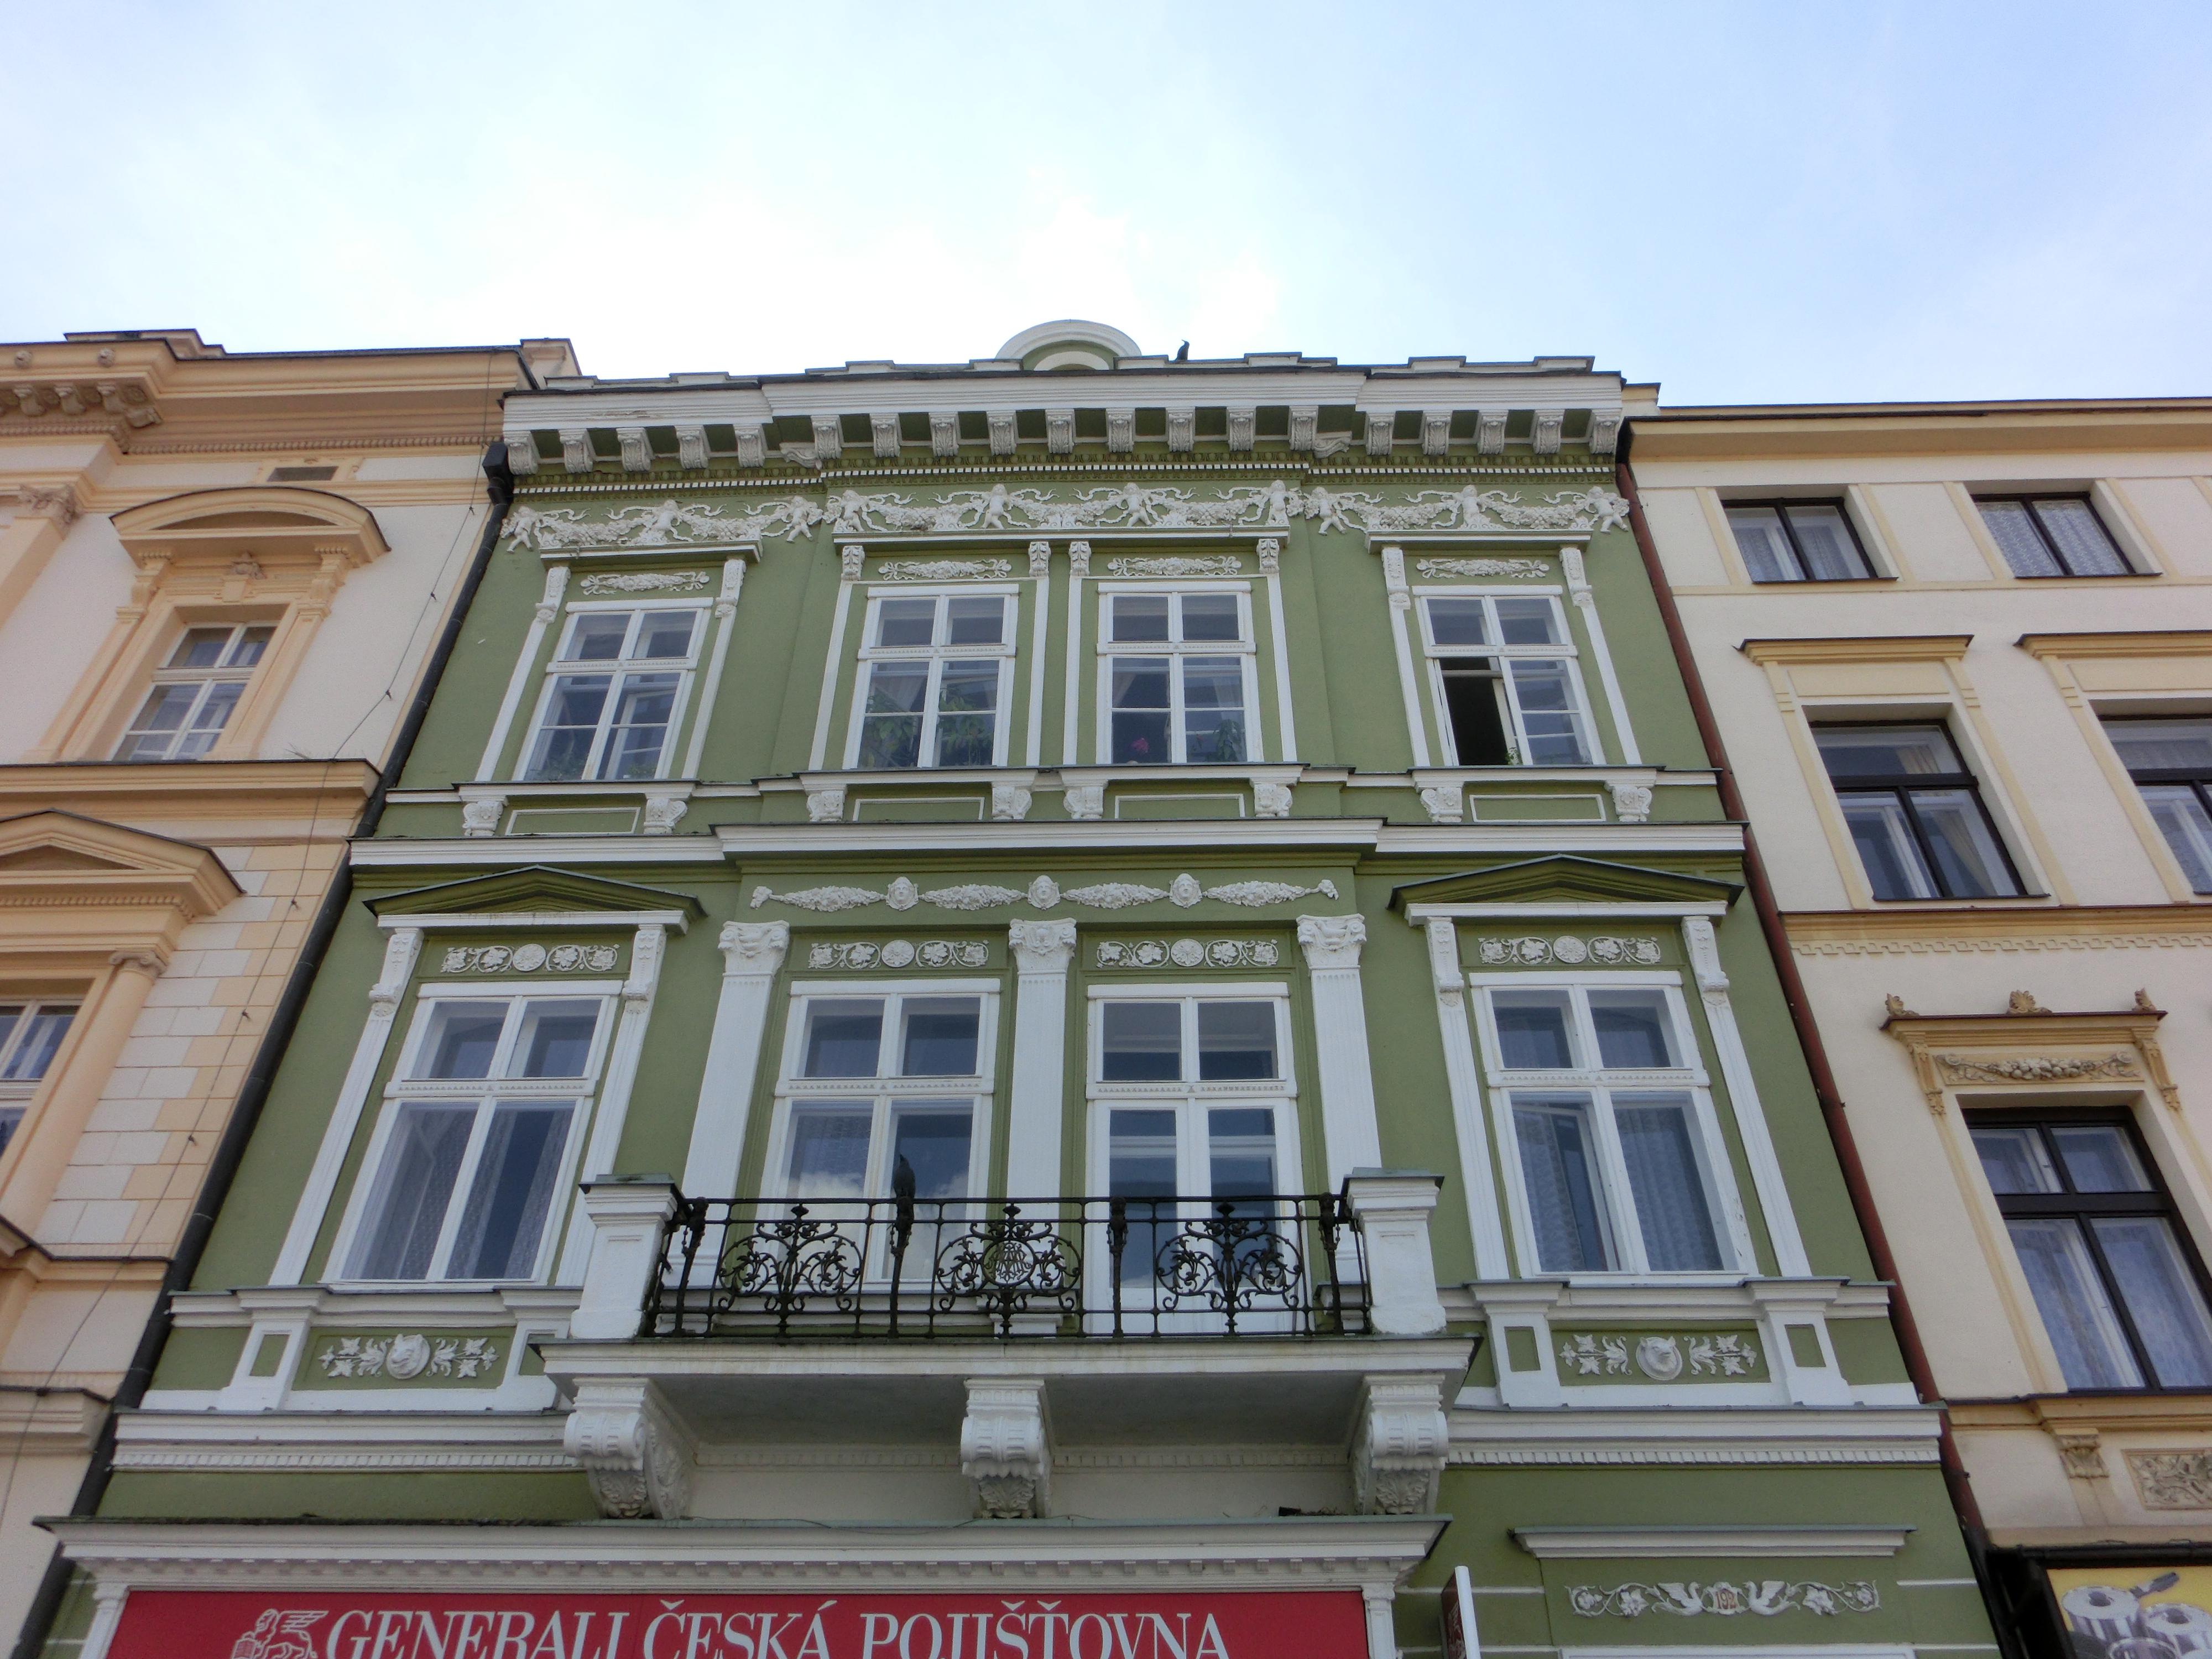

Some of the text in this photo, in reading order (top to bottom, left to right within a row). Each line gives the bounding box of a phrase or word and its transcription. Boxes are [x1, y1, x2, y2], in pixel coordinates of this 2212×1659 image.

[326, 1600, 1231, 1659] GENERALI ČESKÁ POJIŠŤOVNA
